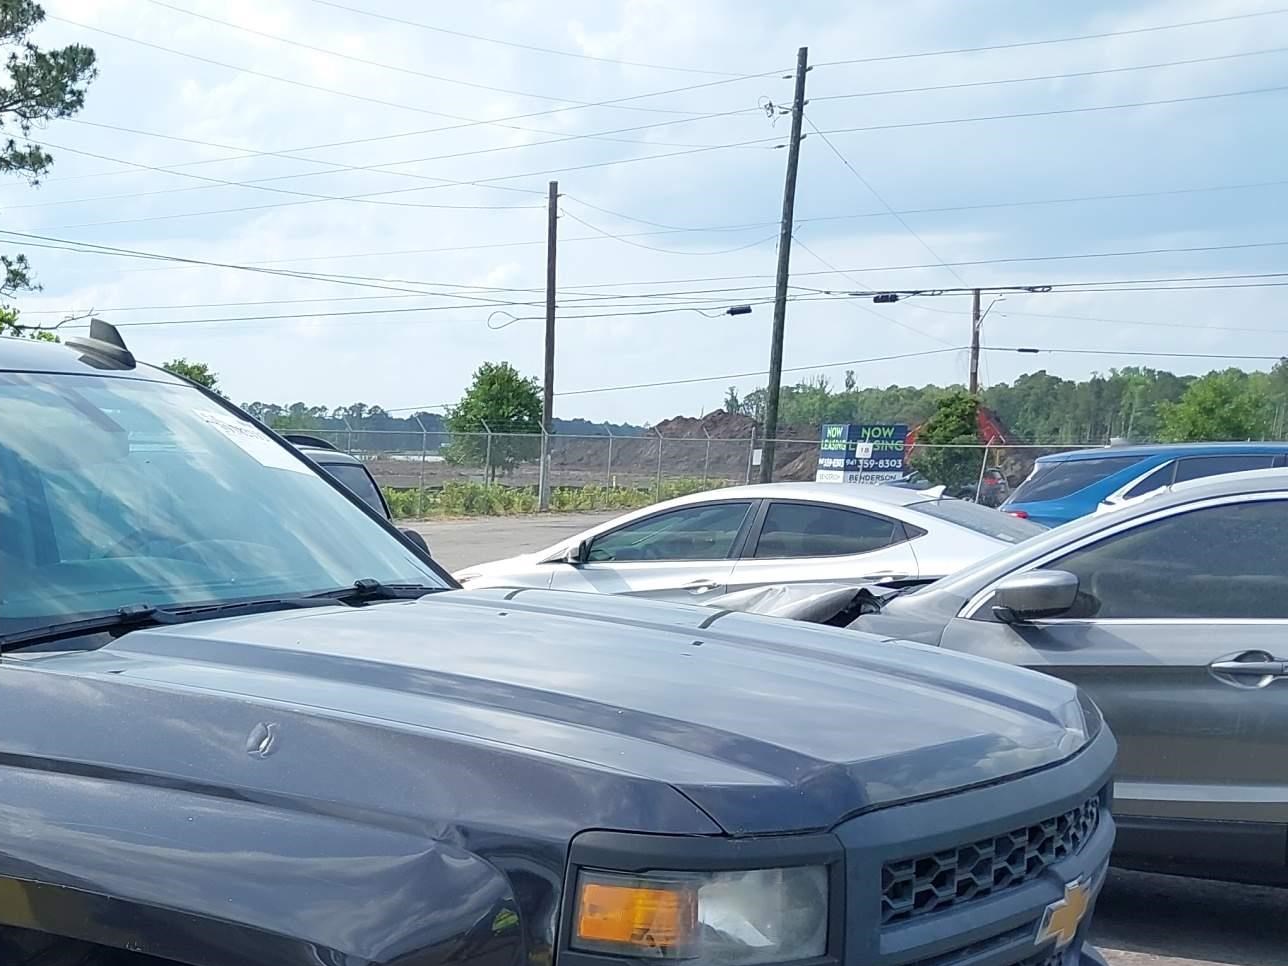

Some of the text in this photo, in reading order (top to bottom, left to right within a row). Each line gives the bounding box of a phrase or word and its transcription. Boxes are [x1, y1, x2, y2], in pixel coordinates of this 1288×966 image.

[827, 427, 844, 438] NOW
[861, 427, 895, 438] NOW
[821, 440, 847, 450] LEASING
[848, 440, 905, 451] LSING
[857, 459, 903, 468] 359-8303
